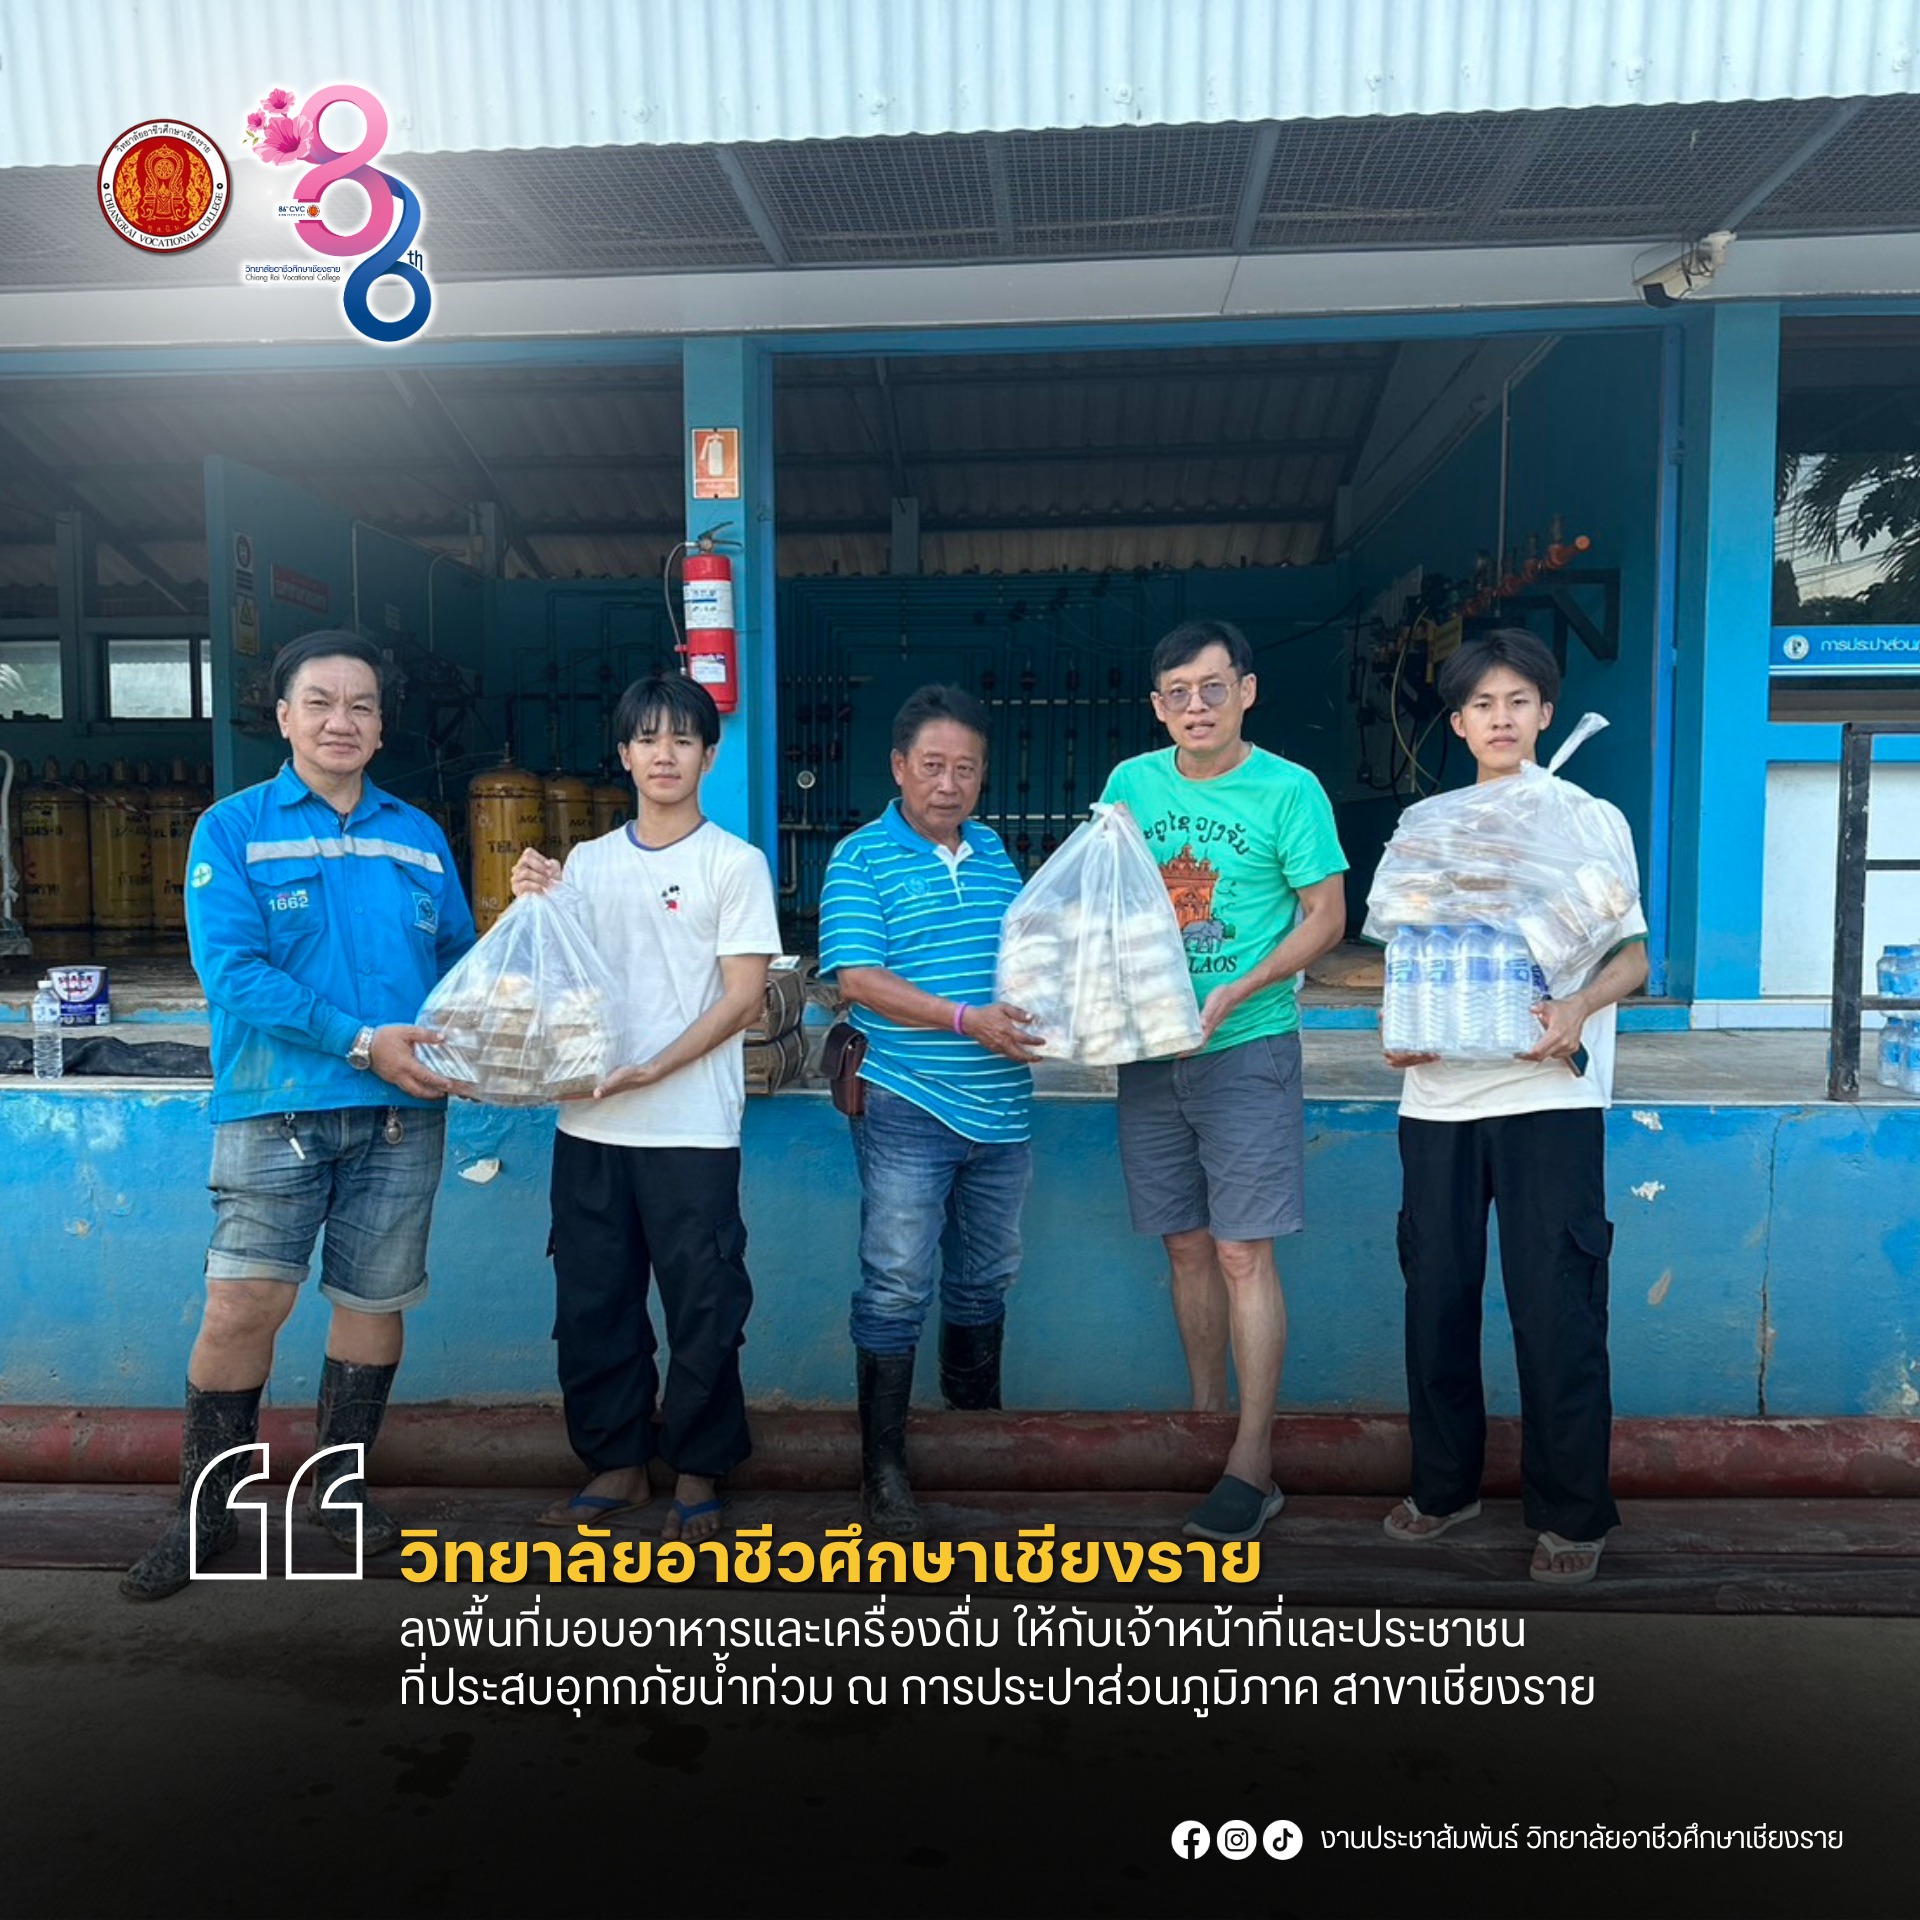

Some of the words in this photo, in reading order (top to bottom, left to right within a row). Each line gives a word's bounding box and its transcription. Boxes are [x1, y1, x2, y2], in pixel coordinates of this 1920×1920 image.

[1821, 636, 1920, 653] การประปาส่วน
[268, 895, 310, 912] 1662
[1188, 956, 1238, 974] LAOS
